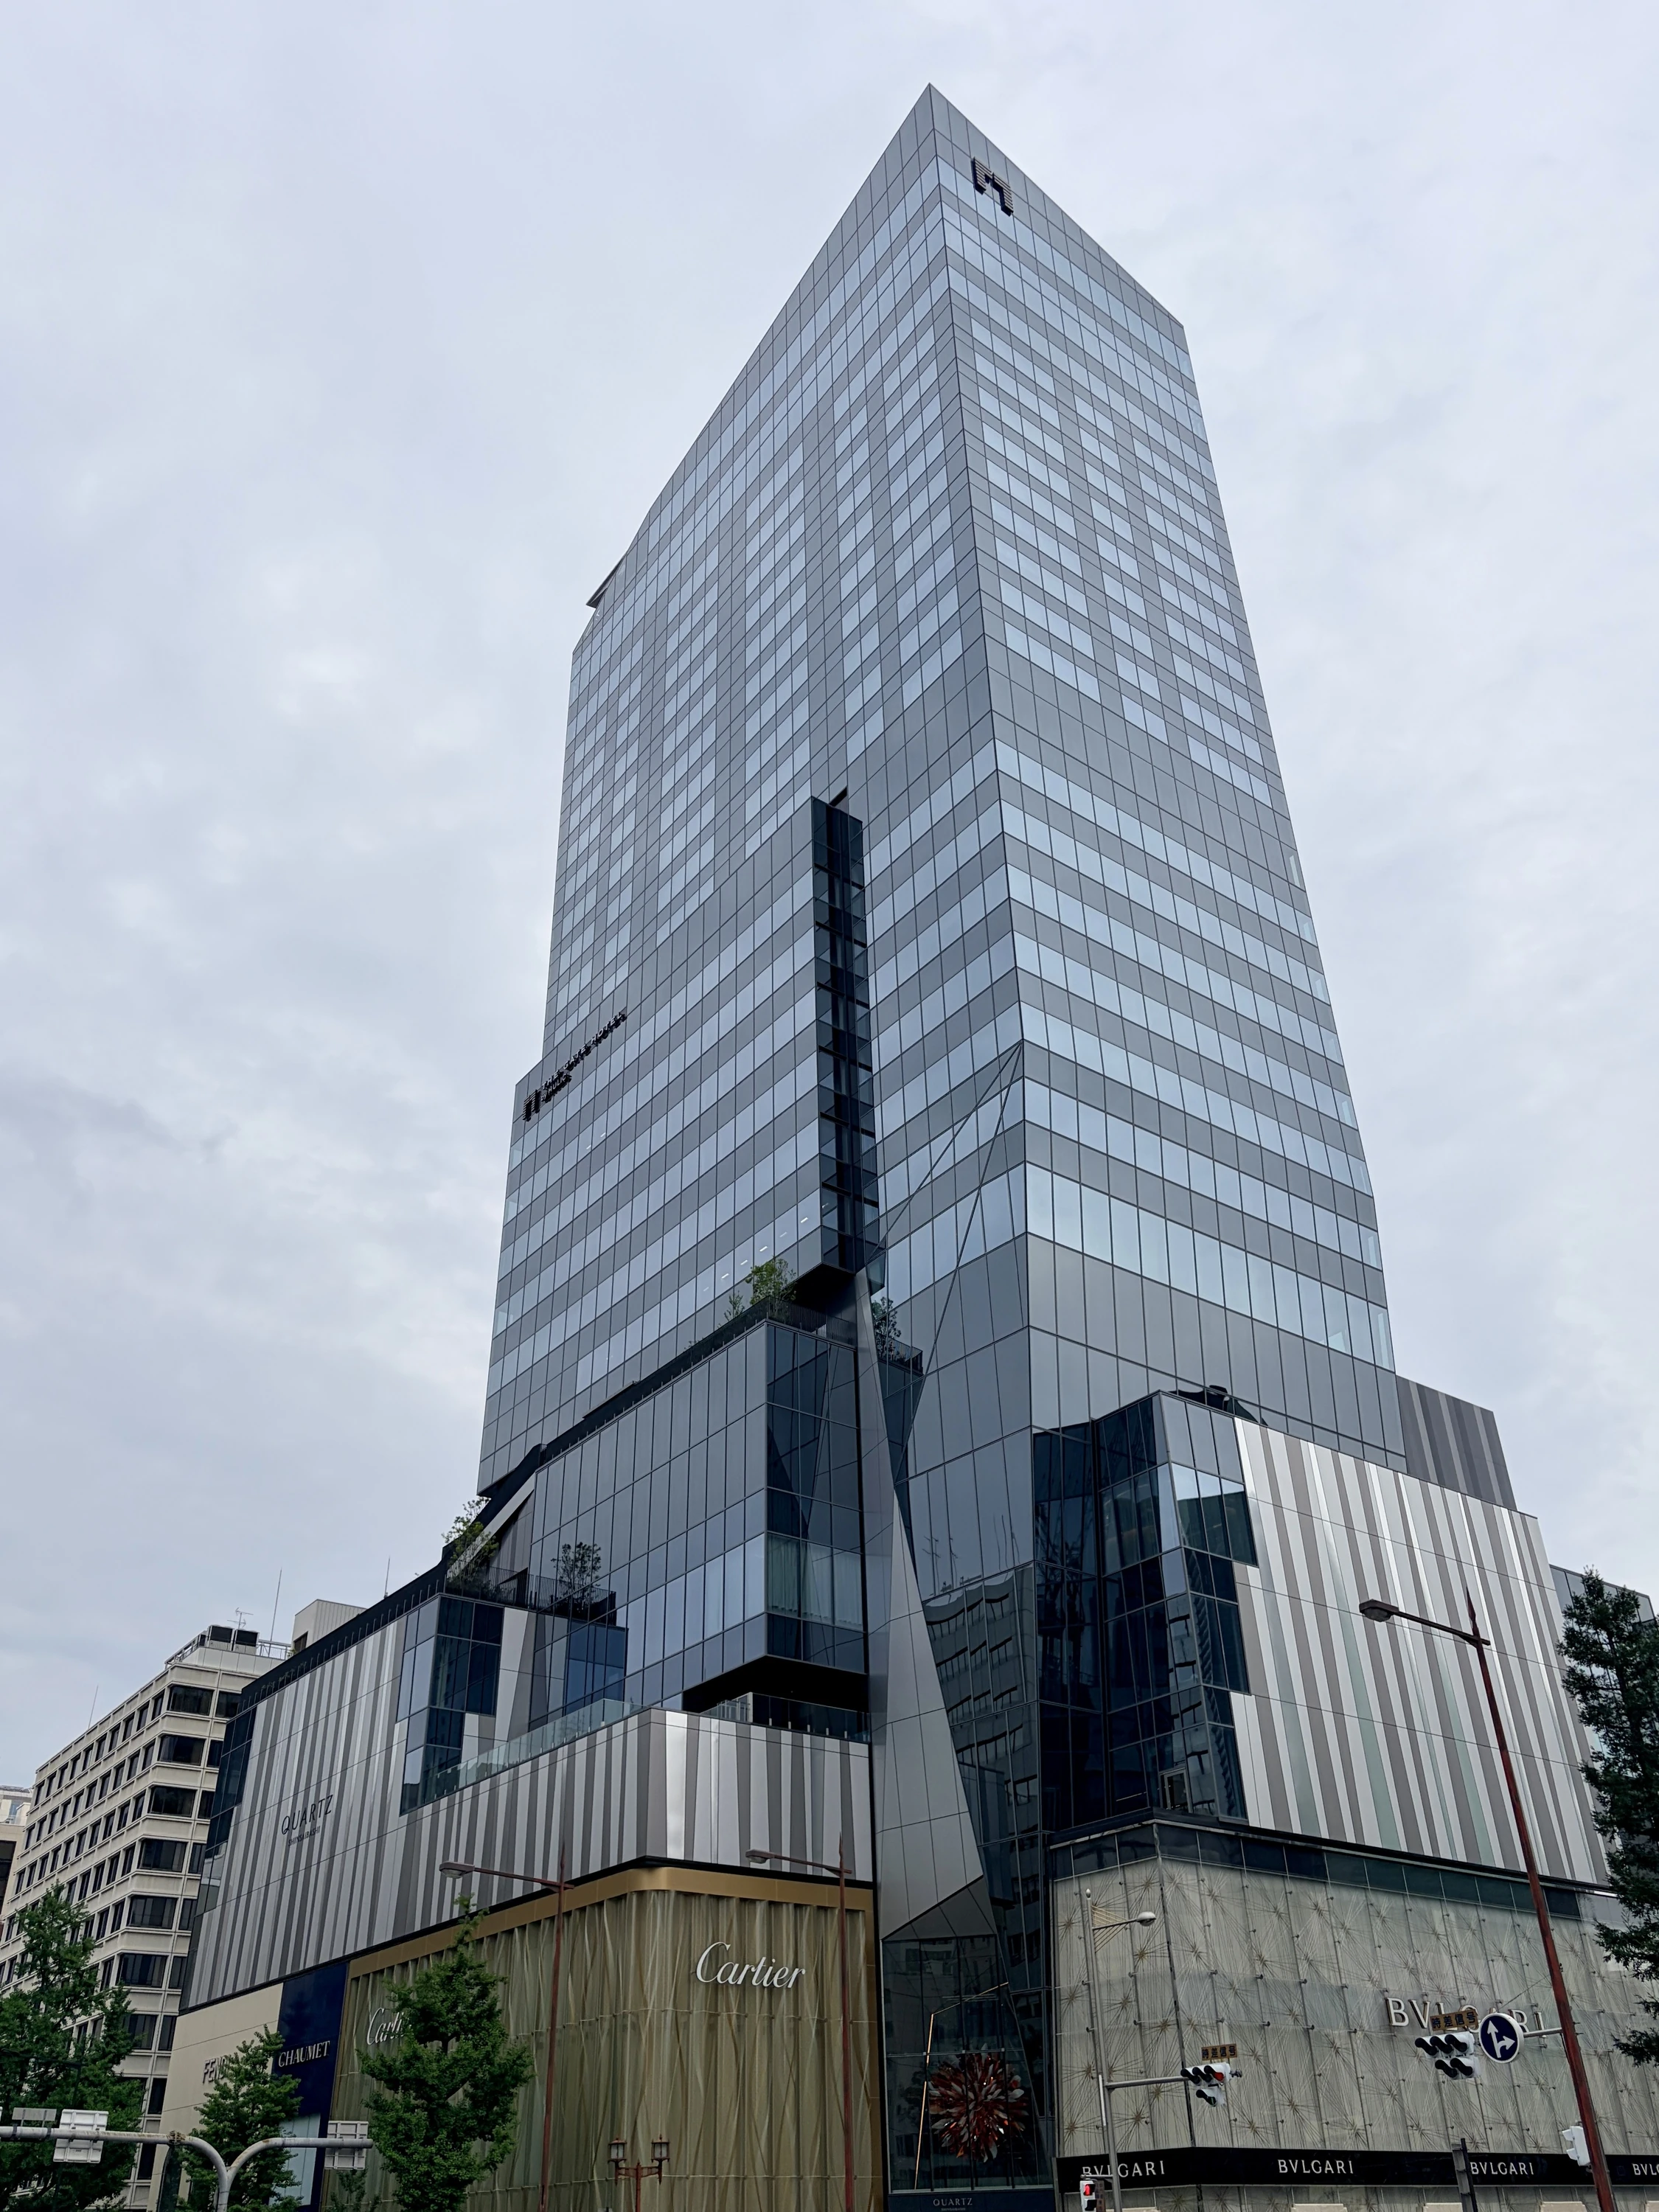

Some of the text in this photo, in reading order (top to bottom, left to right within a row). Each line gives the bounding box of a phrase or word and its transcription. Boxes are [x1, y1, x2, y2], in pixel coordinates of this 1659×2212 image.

[542, 1012, 625, 1090] THE GATE HOTEL
[548, 1073, 569, 1096] HULIC
[281, 1794, 333, 1835] QUARTZ
[696, 1941, 806, 1989] Cartier
[366, 2007, 411, 2045] Carti
[1384, 1997, 1547, 2038] BVGRI
[1432, 2011, 1475, 2029] 時差信号
[278, 2041, 330, 2067] CHAUMET
[1202, 2045, 1237, 2059] 時差信号
[202, 2056, 230, 2084] FEND
[1278, 2159, 1354, 2174] BVLGARI
[1470, 2161, 1534, 2175] BVLGARI
[1632, 2163, 1659, 2175] BVL
